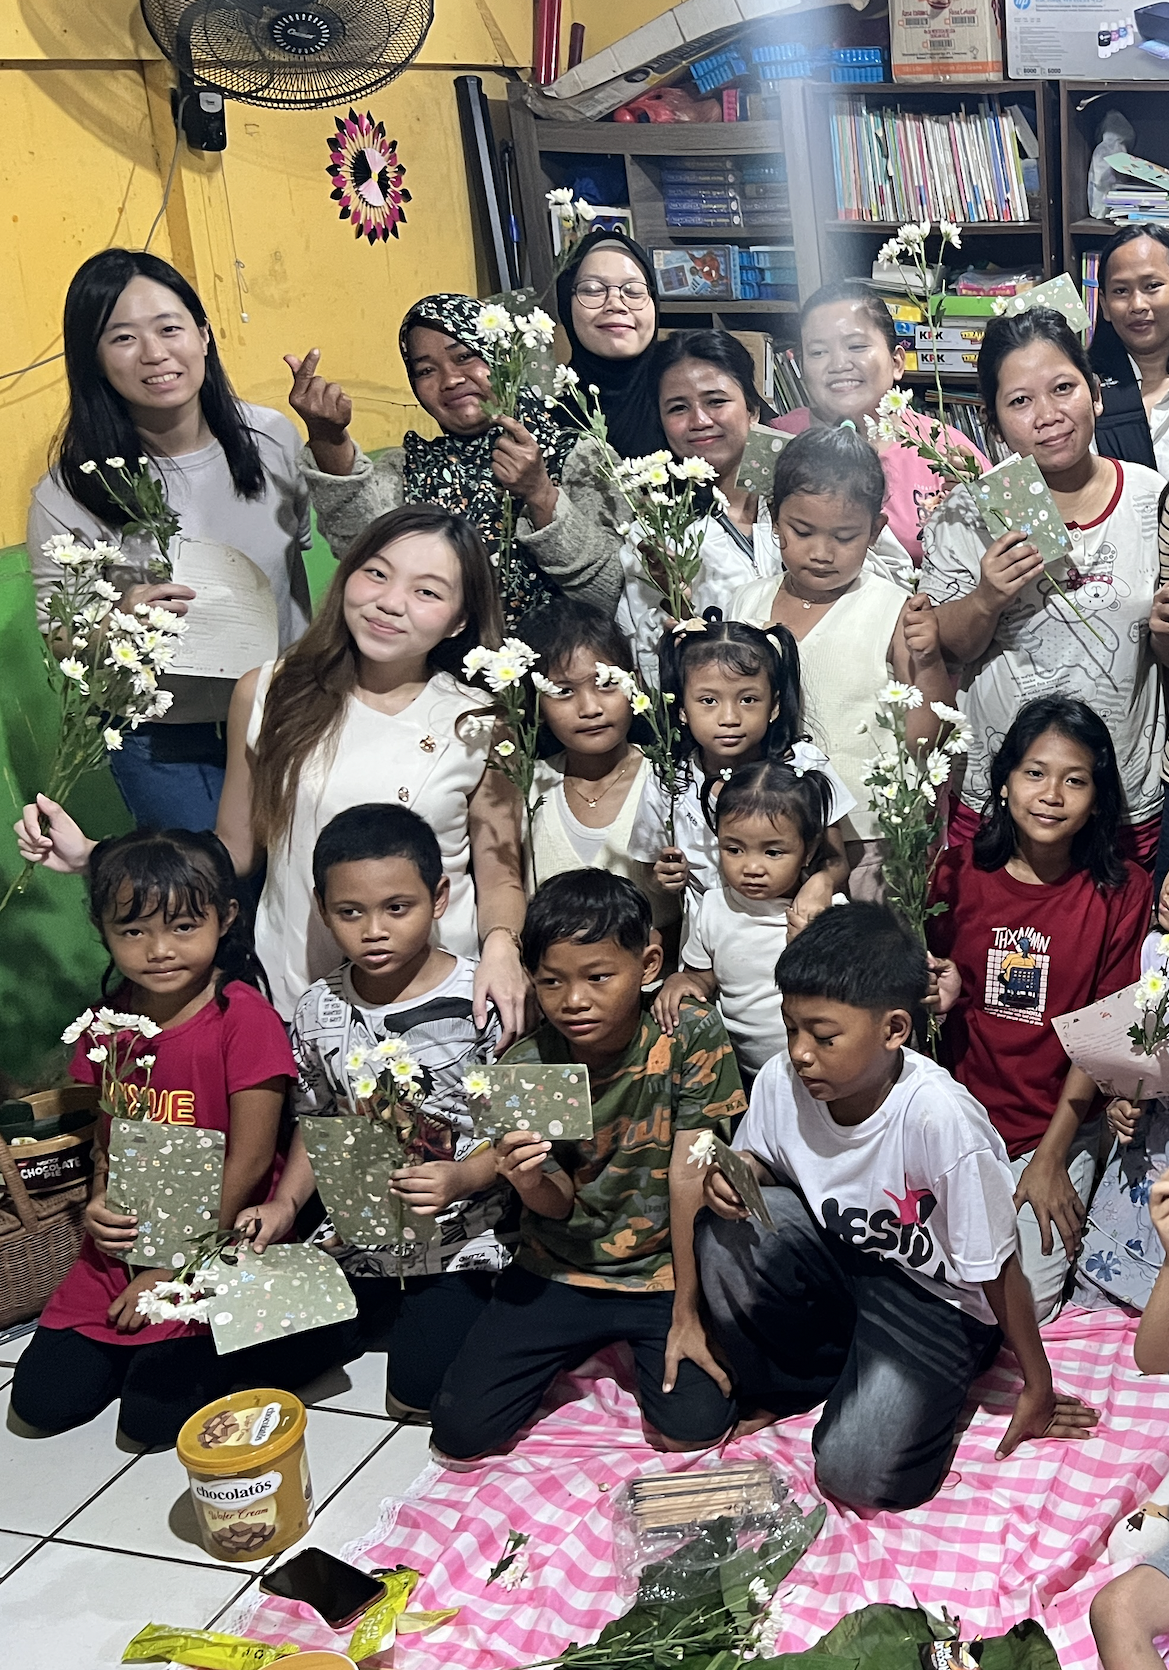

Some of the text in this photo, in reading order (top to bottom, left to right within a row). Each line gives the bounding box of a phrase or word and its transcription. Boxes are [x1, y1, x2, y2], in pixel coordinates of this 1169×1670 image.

[20, 1156, 81, 1180] CHOCOLATE
[43, 1170, 62, 1180] PIE
[208, 1508, 269, 1522] Wafer Cream
